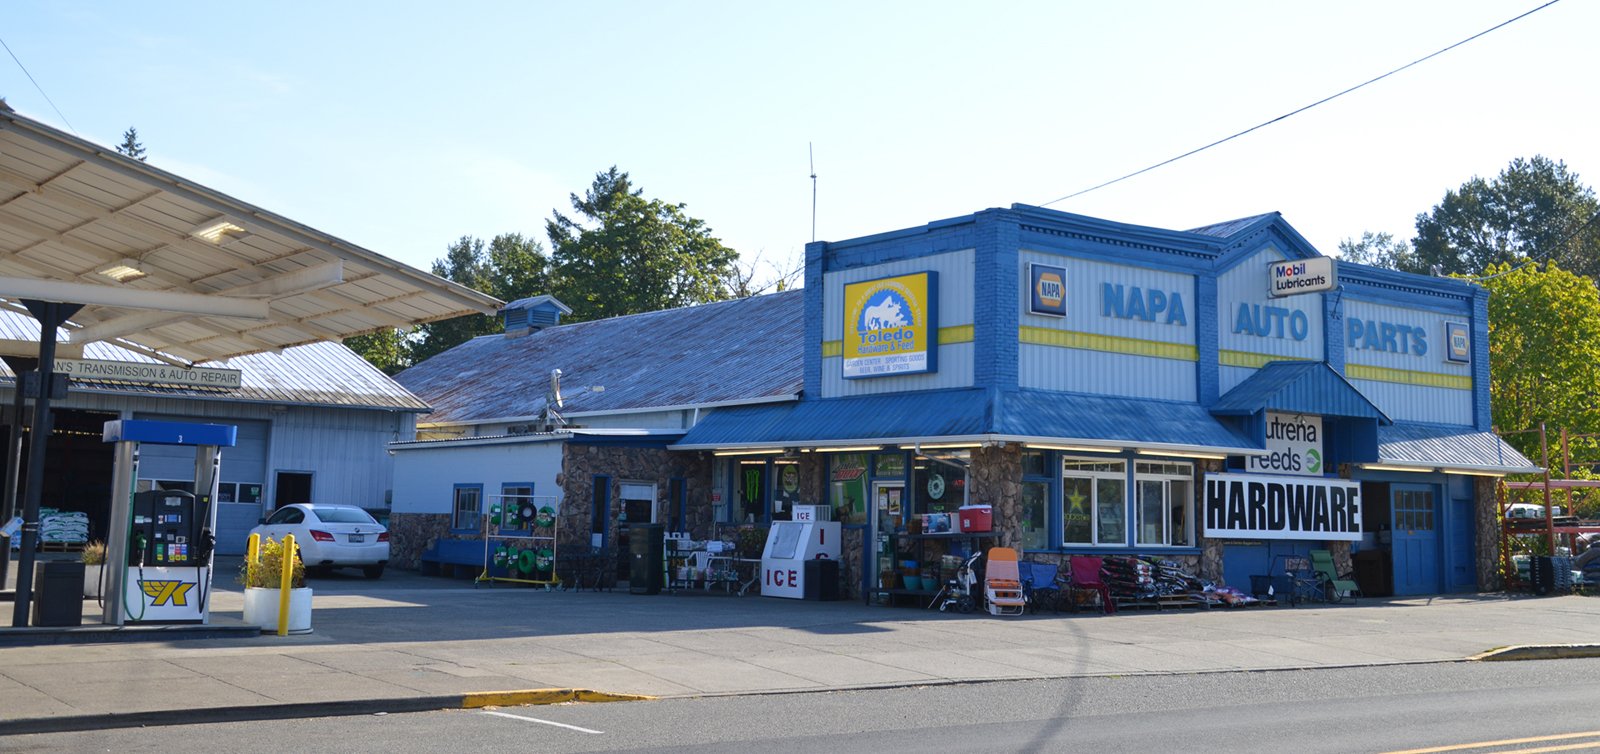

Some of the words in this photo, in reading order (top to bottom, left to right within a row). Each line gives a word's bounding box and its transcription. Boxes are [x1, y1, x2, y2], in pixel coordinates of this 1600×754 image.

[1276, 263, 1306, 278] Mobil
[1041, 281, 1060, 298] NAPA
[1276, 275, 1326, 290] Lubricants
[1103, 282, 1187, 327] NAPA
[1233, 302, 1309, 342] AUTO
[1347, 317, 1427, 357] PARTS
[858, 327, 914, 345] Toledo
[1453, 335, 1466, 349] NAPA
[858, 344, 888, 354] Hardware
[890, 341, 896, 351] &
[898, 339, 915, 350] Feed
[54, 361, 73, 372] N'S
[79, 362, 157, 378] TRANSMISSION
[160, 368, 166, 378] &
[169, 369, 197, 381] AUTO
[201, 371, 238, 383] REPAIR
[1266, 416, 1317, 443] utrena
[178, 434, 183, 444] 3
[1207, 480, 1361, 533] HARDWARE
[797, 512, 810, 520] ICE
[766, 569, 797, 587] ICE
